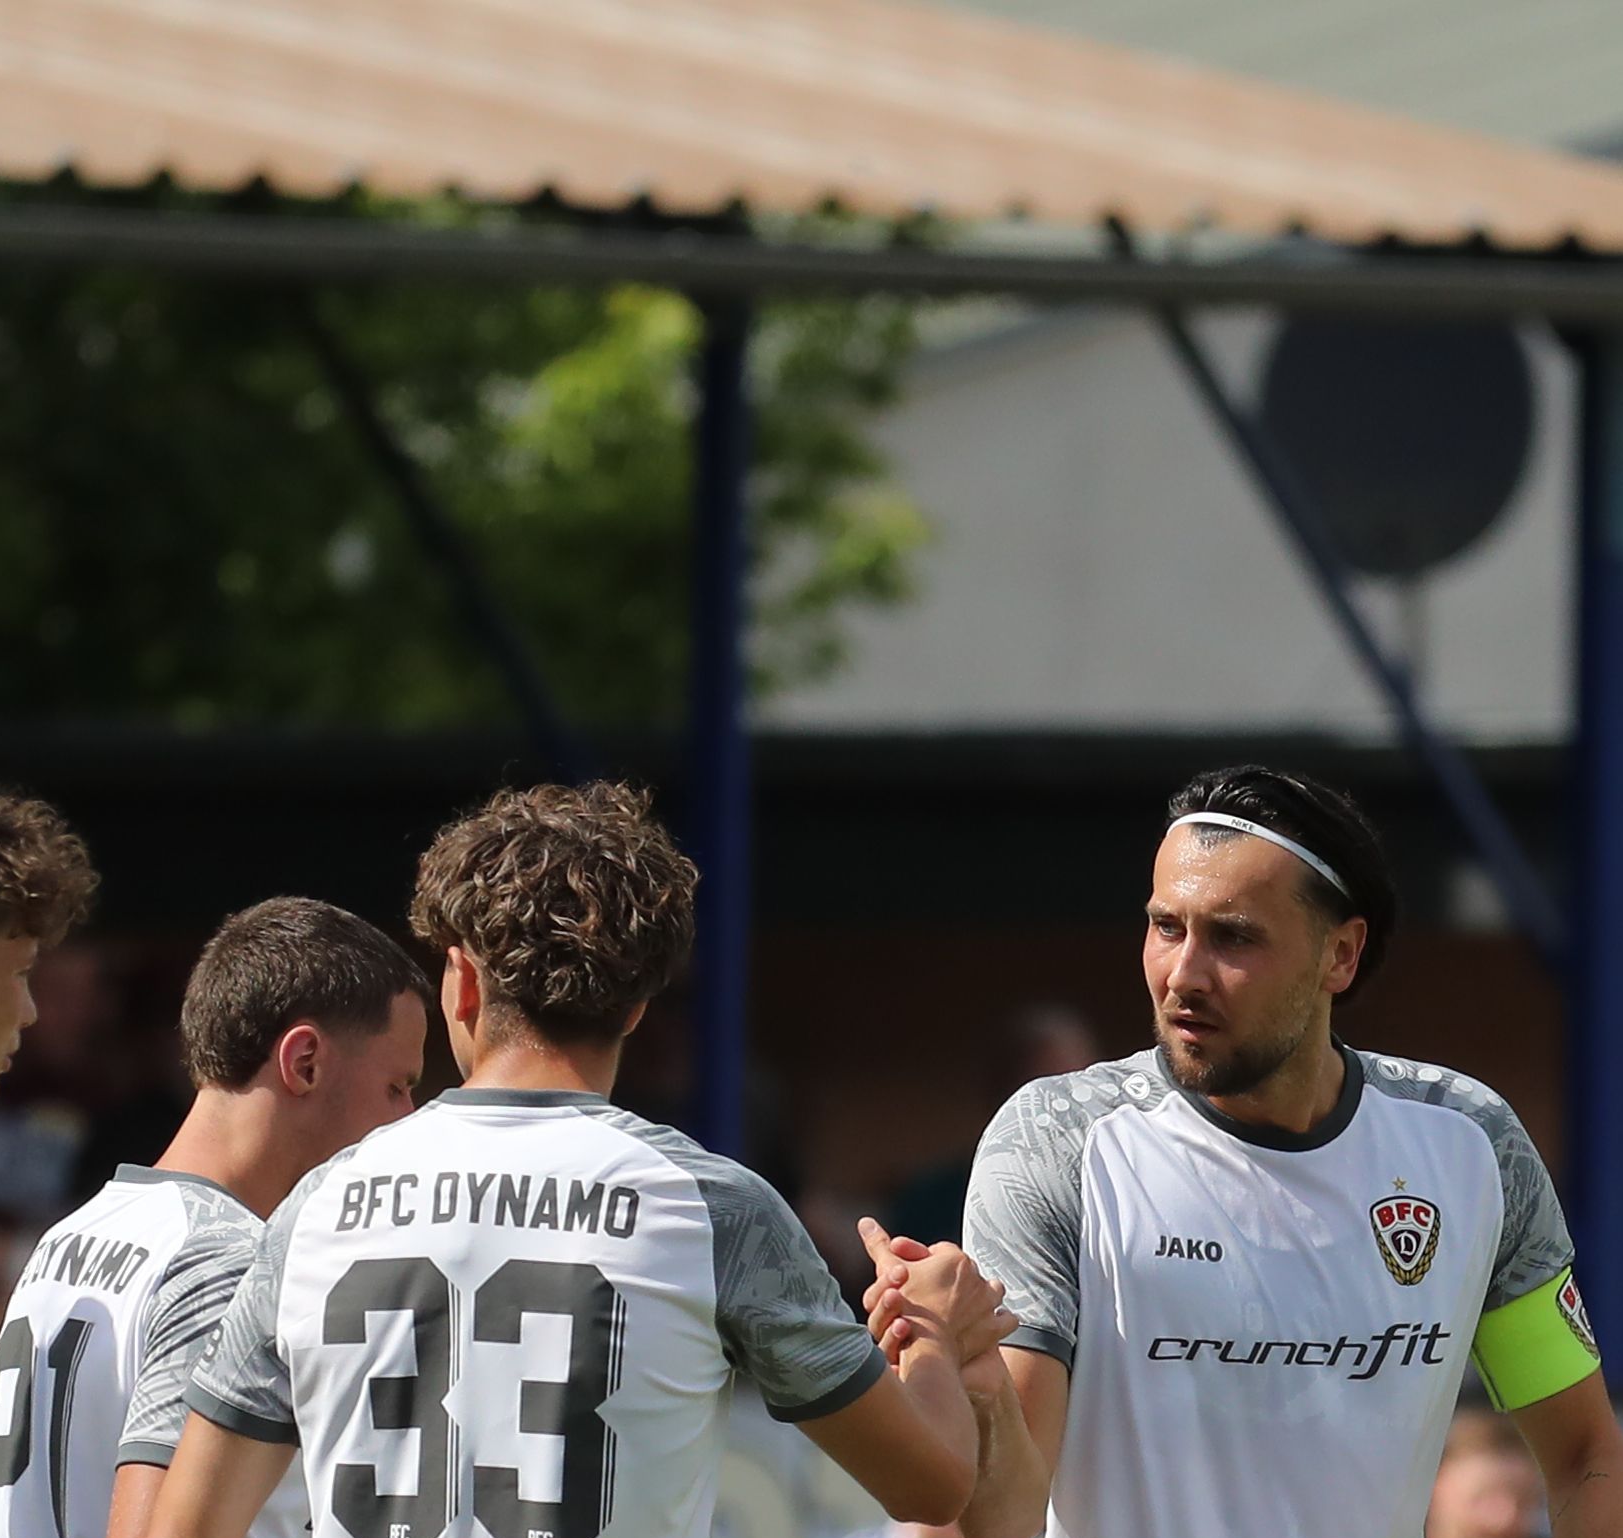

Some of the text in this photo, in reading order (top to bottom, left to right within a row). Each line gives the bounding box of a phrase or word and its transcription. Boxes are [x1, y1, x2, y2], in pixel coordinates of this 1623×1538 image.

[336, 1172, 640, 1239] BFC DYNAMO
[1376, 1201, 1431, 1228] BFC
[1154, 1236, 1223, 1263] JAKO
[1146, 1322, 1453, 1381] crunchfit
